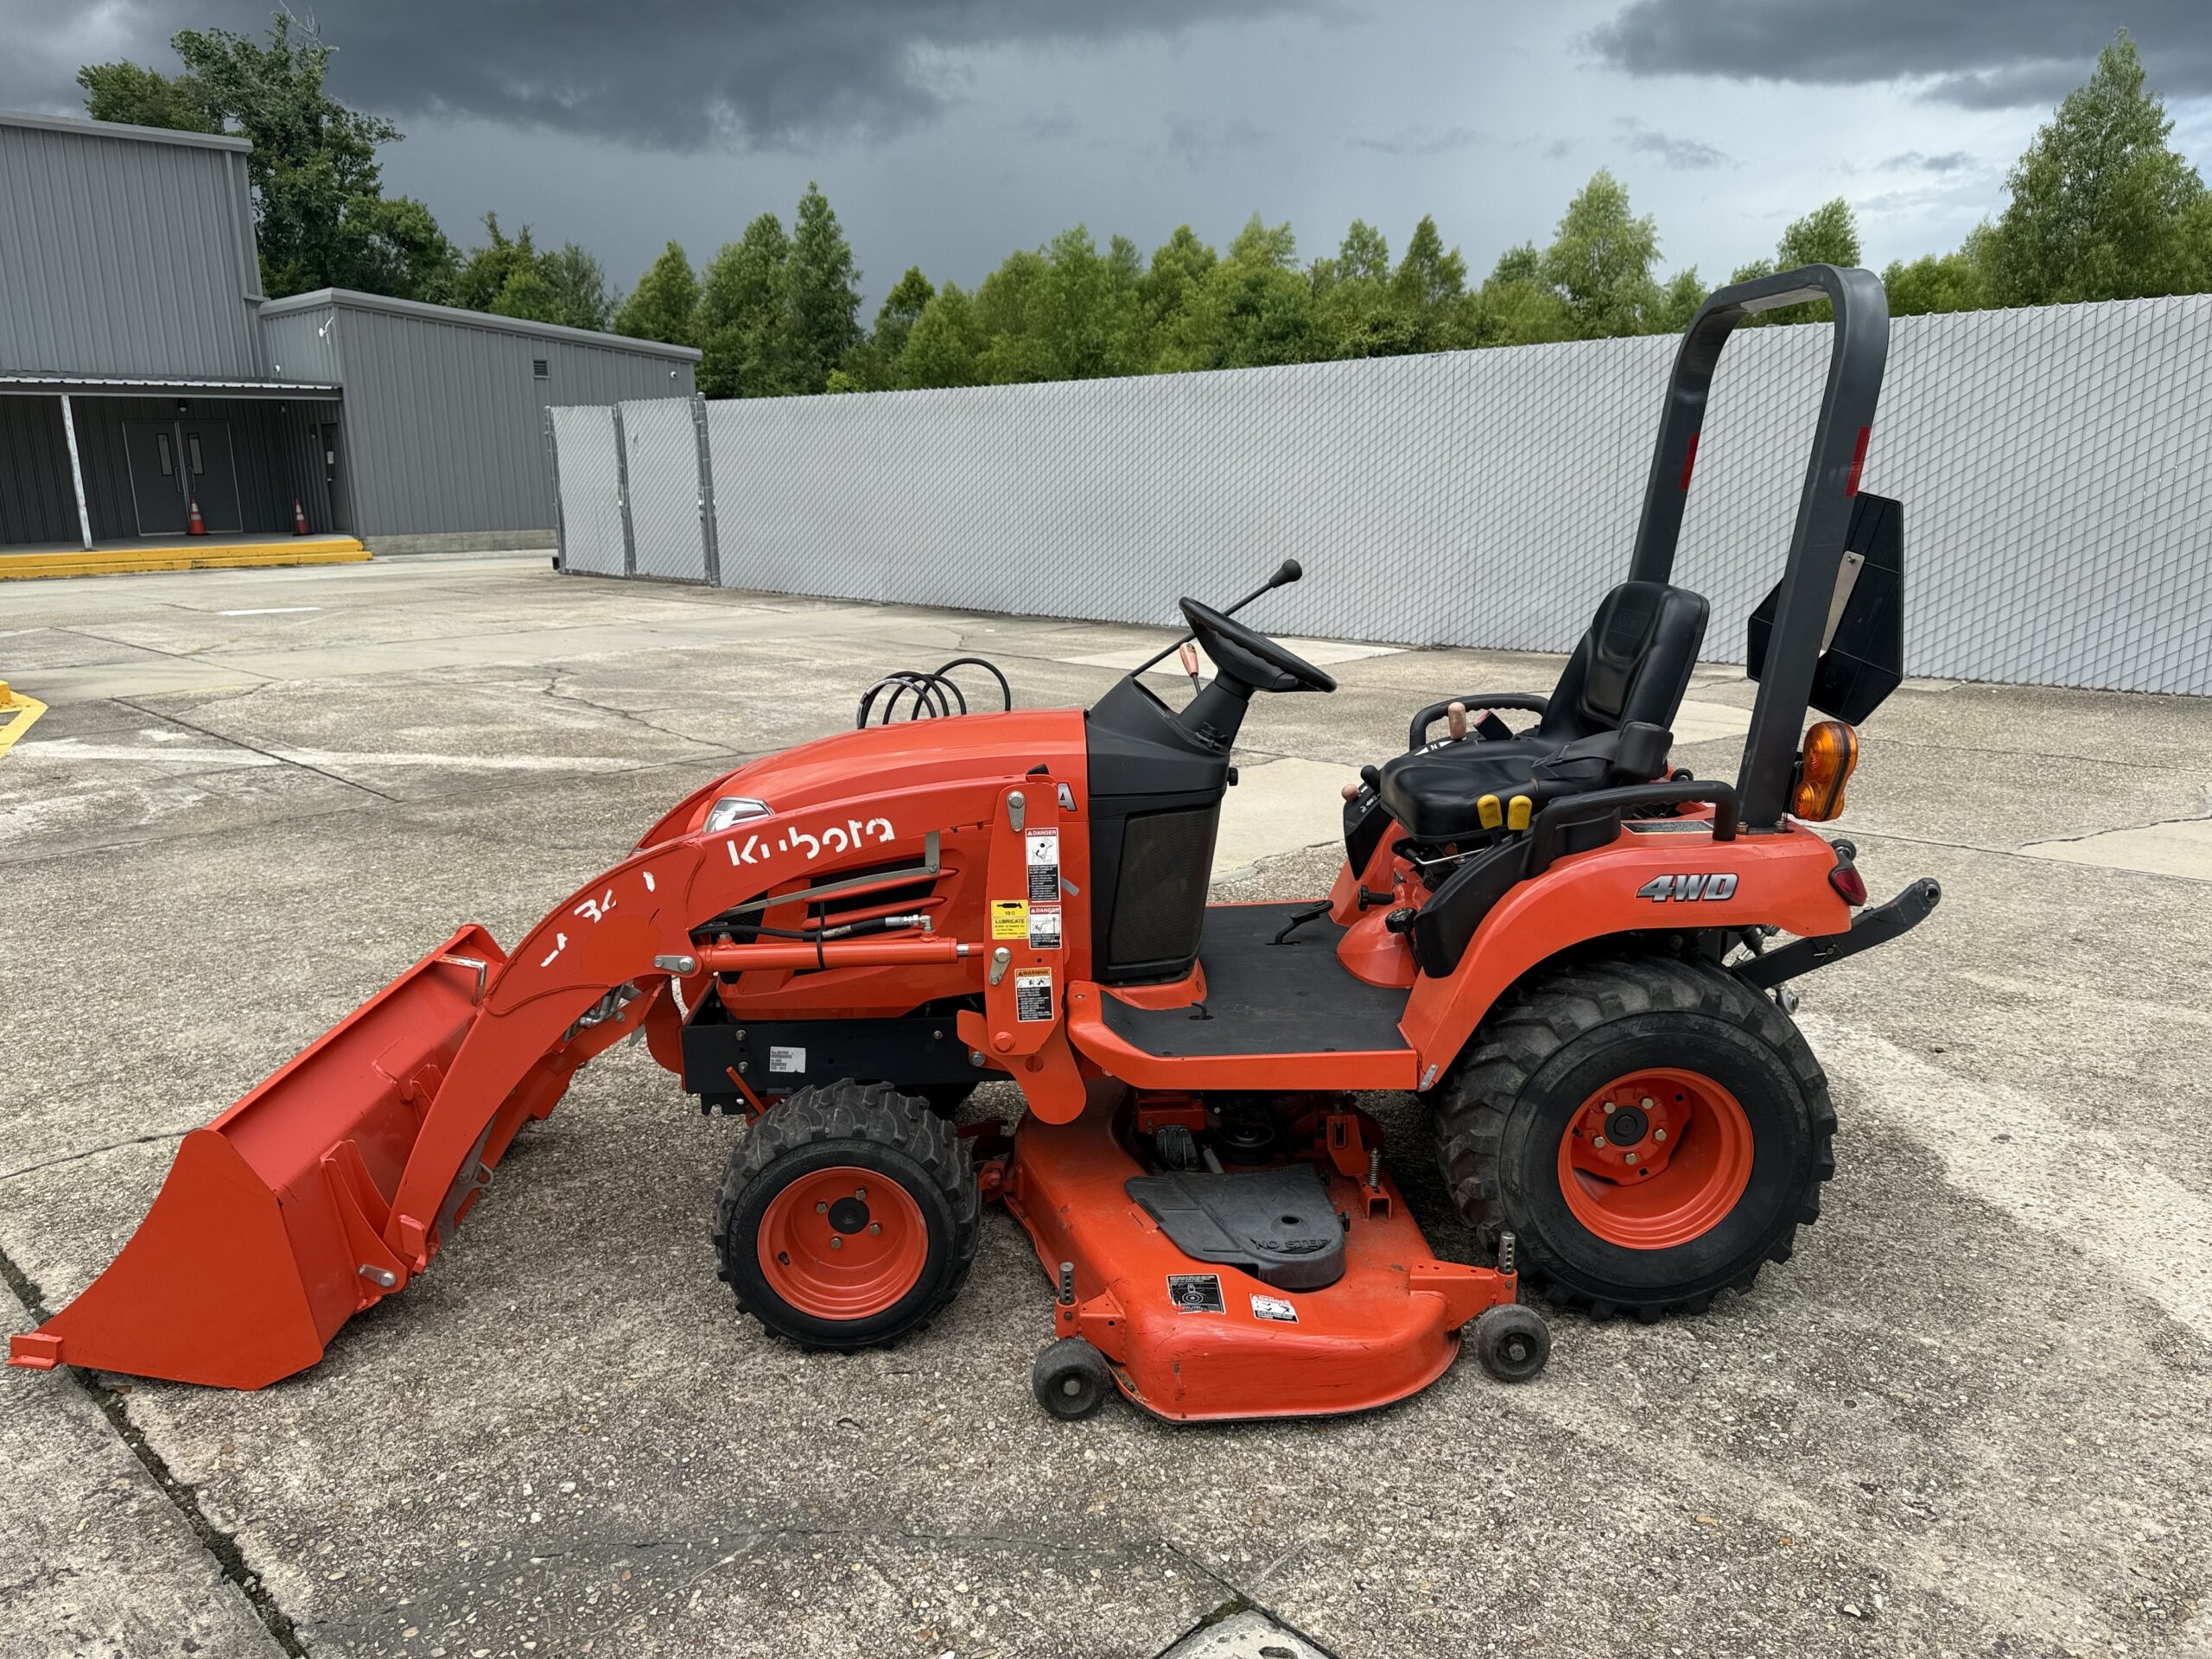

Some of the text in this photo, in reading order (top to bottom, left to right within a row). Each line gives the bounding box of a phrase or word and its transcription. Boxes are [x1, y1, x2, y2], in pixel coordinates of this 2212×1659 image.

[1636, 873, 1739, 902] 4WD
[1254, 1239, 1329, 1249] NO STEP
